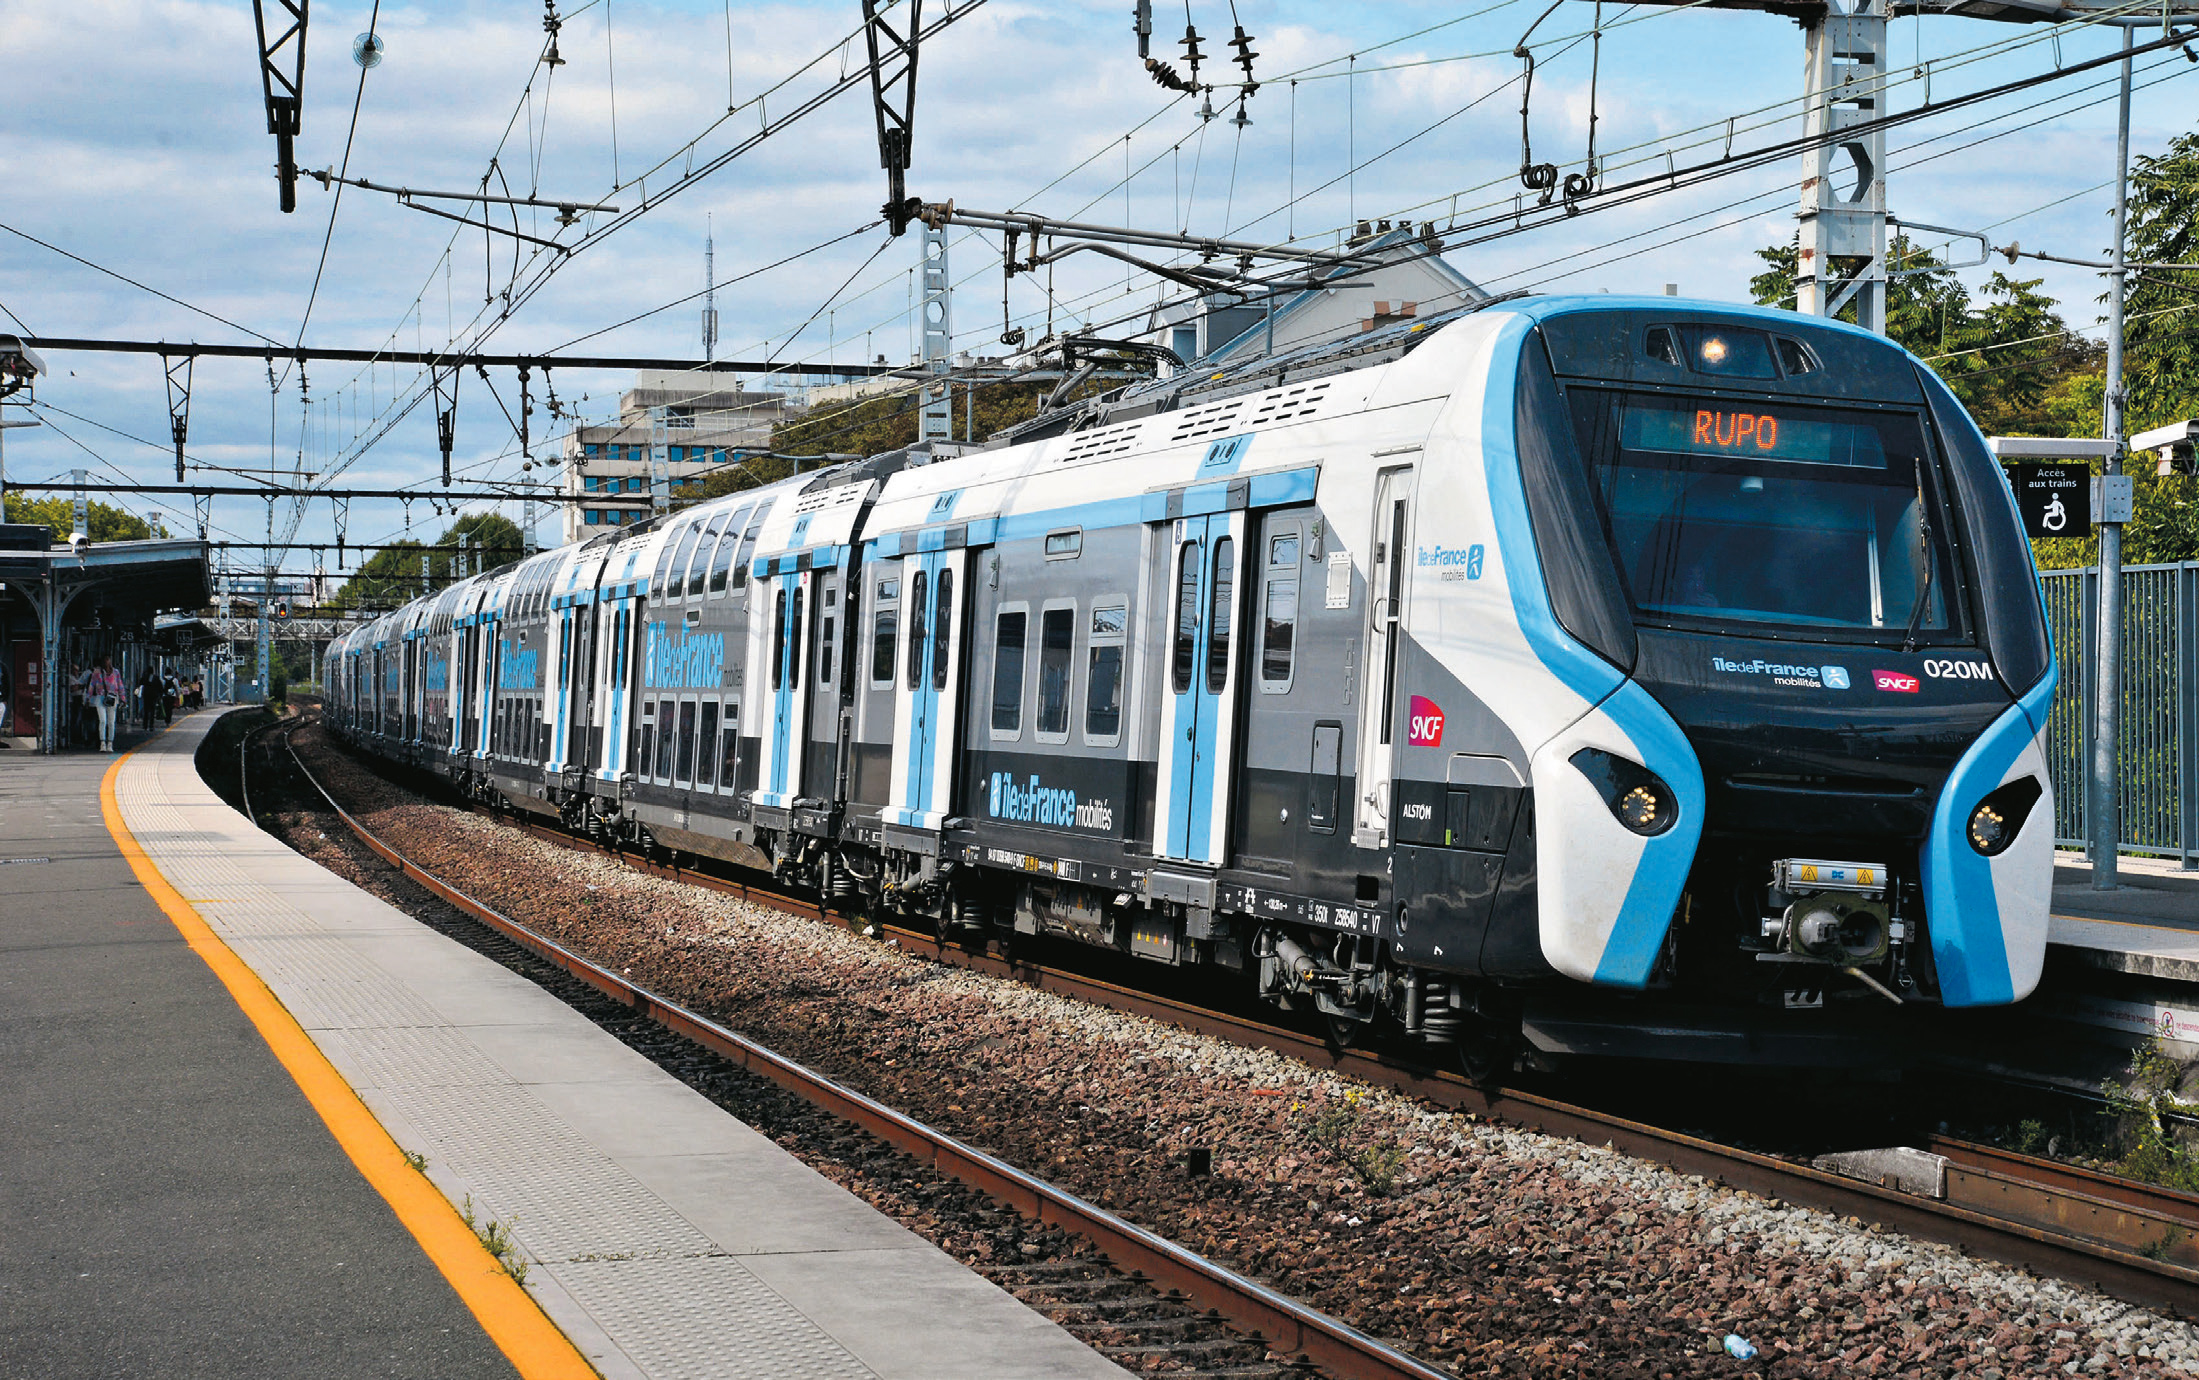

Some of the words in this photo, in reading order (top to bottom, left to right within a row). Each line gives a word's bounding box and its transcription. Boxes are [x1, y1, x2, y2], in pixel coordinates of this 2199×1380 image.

[1694, 410, 1777, 449] RUPO
[2037, 468, 2065, 477] Accès
[2049, 479, 2077, 488] trains
[1924, 659, 1994, 680] 020M
[1774, 677, 1821, 688] mobilités
[1878, 677, 1917, 690] SNCF
[1410, 715, 1442, 740] SNCF
[1076, 799, 1112, 830] mobilités
[1387, 856, 1392, 874] 2
